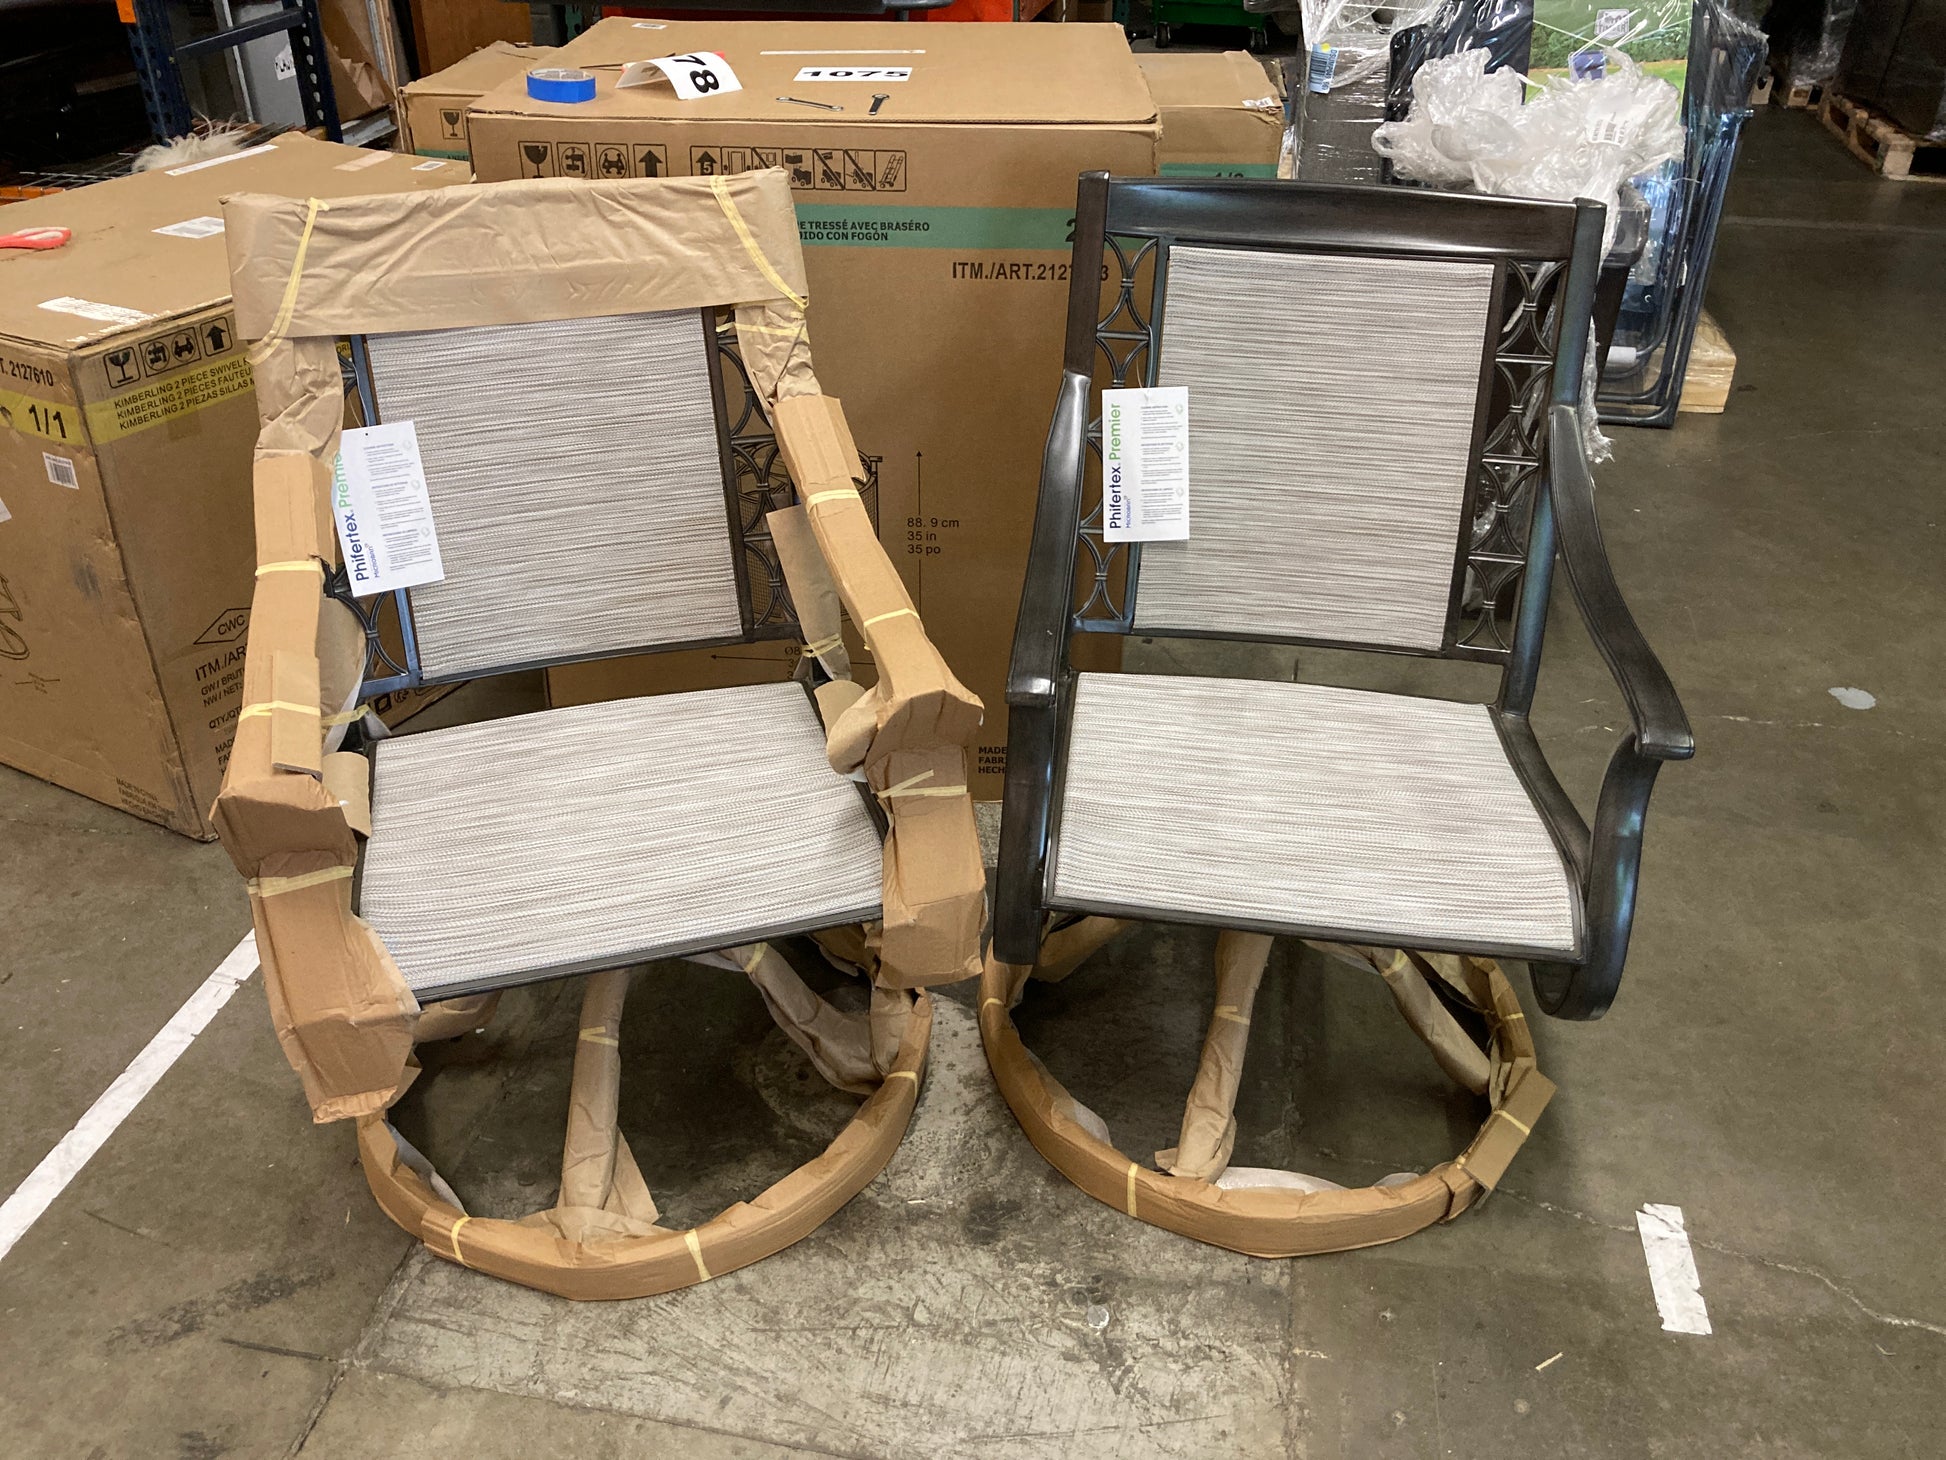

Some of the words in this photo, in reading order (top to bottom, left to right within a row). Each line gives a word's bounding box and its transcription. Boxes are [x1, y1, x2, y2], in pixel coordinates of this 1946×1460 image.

[802, 70, 909, 78] 1075
[808, 219, 848, 230] TRESSÉ
[850, 222, 878, 230] AVEC
[880, 220, 930, 231] BRASÉRO
[826, 232, 849, 240] CON
[851, 230, 888, 241] FOGÓN
[9, 360, 54, 387] 2127610
[114, 383, 173, 409] KIMBERLING
[175, 381, 181, 389] 2
[181, 371, 208, 387] PIECE
[209, 359, 241, 377] SWIVEL
[117, 394, 175, 419] KIMBERLING
[176, 391, 182, 400] 2
[184, 378, 217, 398] PIECES
[119, 404, 178, 430] KIMBERLING
[180, 401, 186, 410] 2
[186, 391, 218, 408] PIEZAS
[220, 379, 249, 396] SILLAS
[28, 404, 67, 439] 1/1
[1108, 403, 1121, 461] Premier
[1109, 466, 1122, 529] Phifertex
[941, 519, 960, 528] cm
[345, 513, 369, 581] Phifertex
[907, 531, 923, 541] 35
[926, 531, 937, 541] in
[907, 544, 923, 554] 35
[926, 546, 941, 556] po
[218, 614, 246, 636] CWC
[201, 681, 216, 696] GW
[221, 668, 245, 686] BRUT
[203, 693, 218, 708] NW
[979, 747, 1007, 755] MADE
